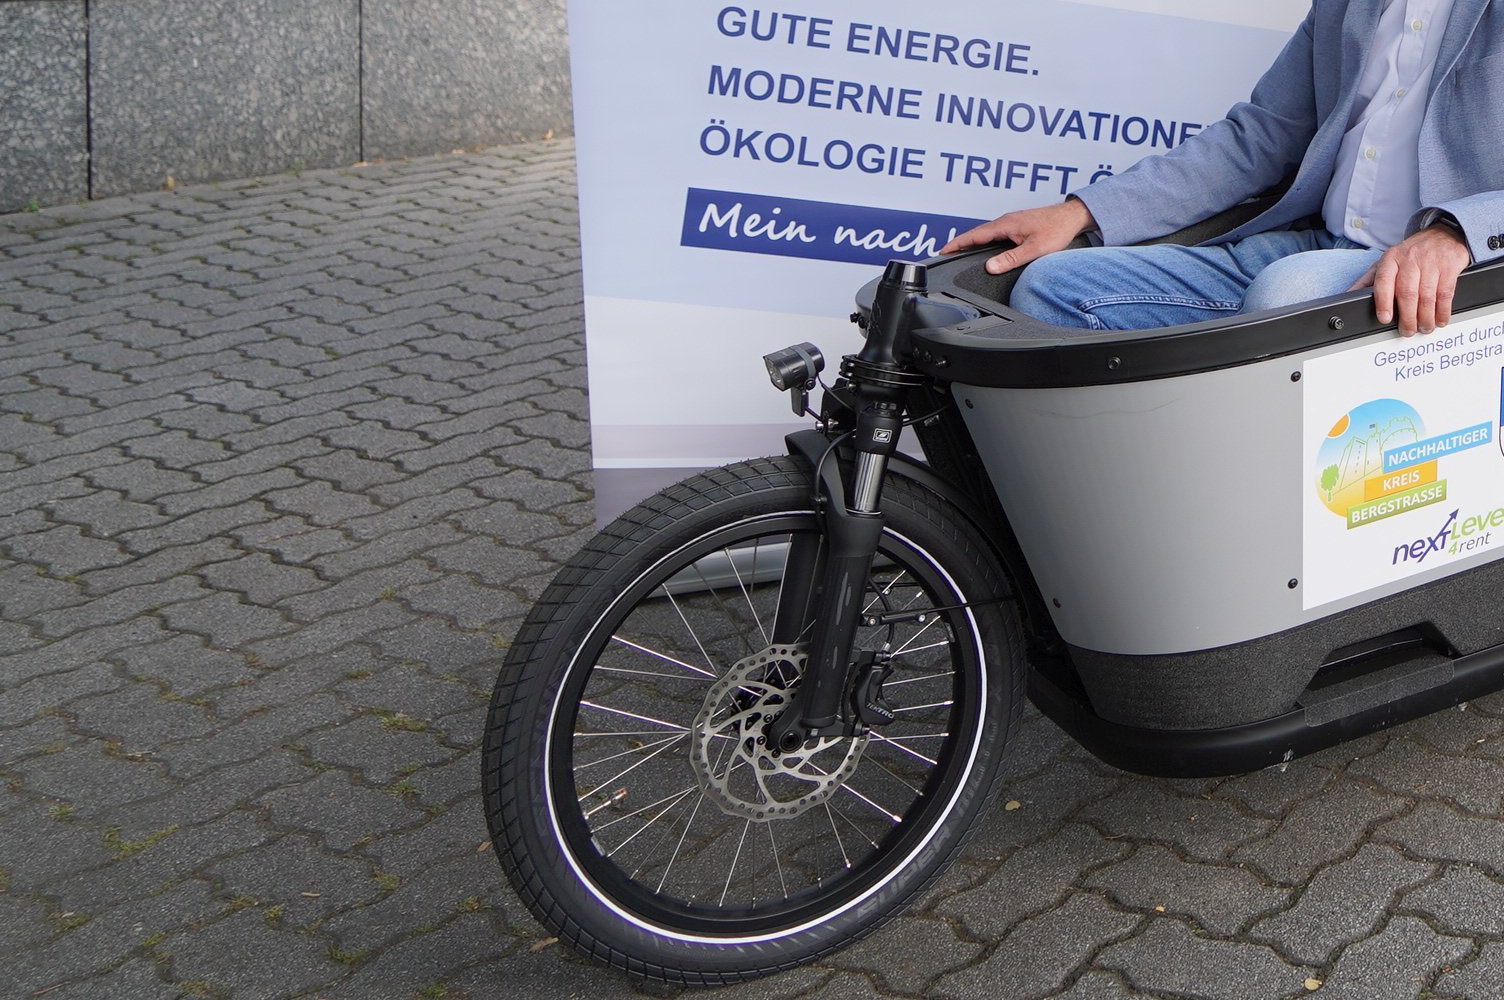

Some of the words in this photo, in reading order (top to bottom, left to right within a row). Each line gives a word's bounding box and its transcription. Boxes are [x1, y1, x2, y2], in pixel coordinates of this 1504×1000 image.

[716, 5, 834, 50] GUTE
[846, 21, 1040, 77] ENERGIE.
[707, 64, 922, 121] MODERNE
[934, 92, 1209, 150] INNOVATIONE
[699, 118, 927, 179] ÖKOLOGIE
[939, 151, 1079, 195] TRIFFT
[698, 202, 816, 244] Mein
[1373, 331, 1464, 367] Gesponsert
[1394, 360, 1434, 382] Kreis
[1387, 427, 1489, 467] NACHHALTIGER
[1382, 469, 1420, 491] KREIS
[1351, 485, 1443, 524] BERGSTRASSE
